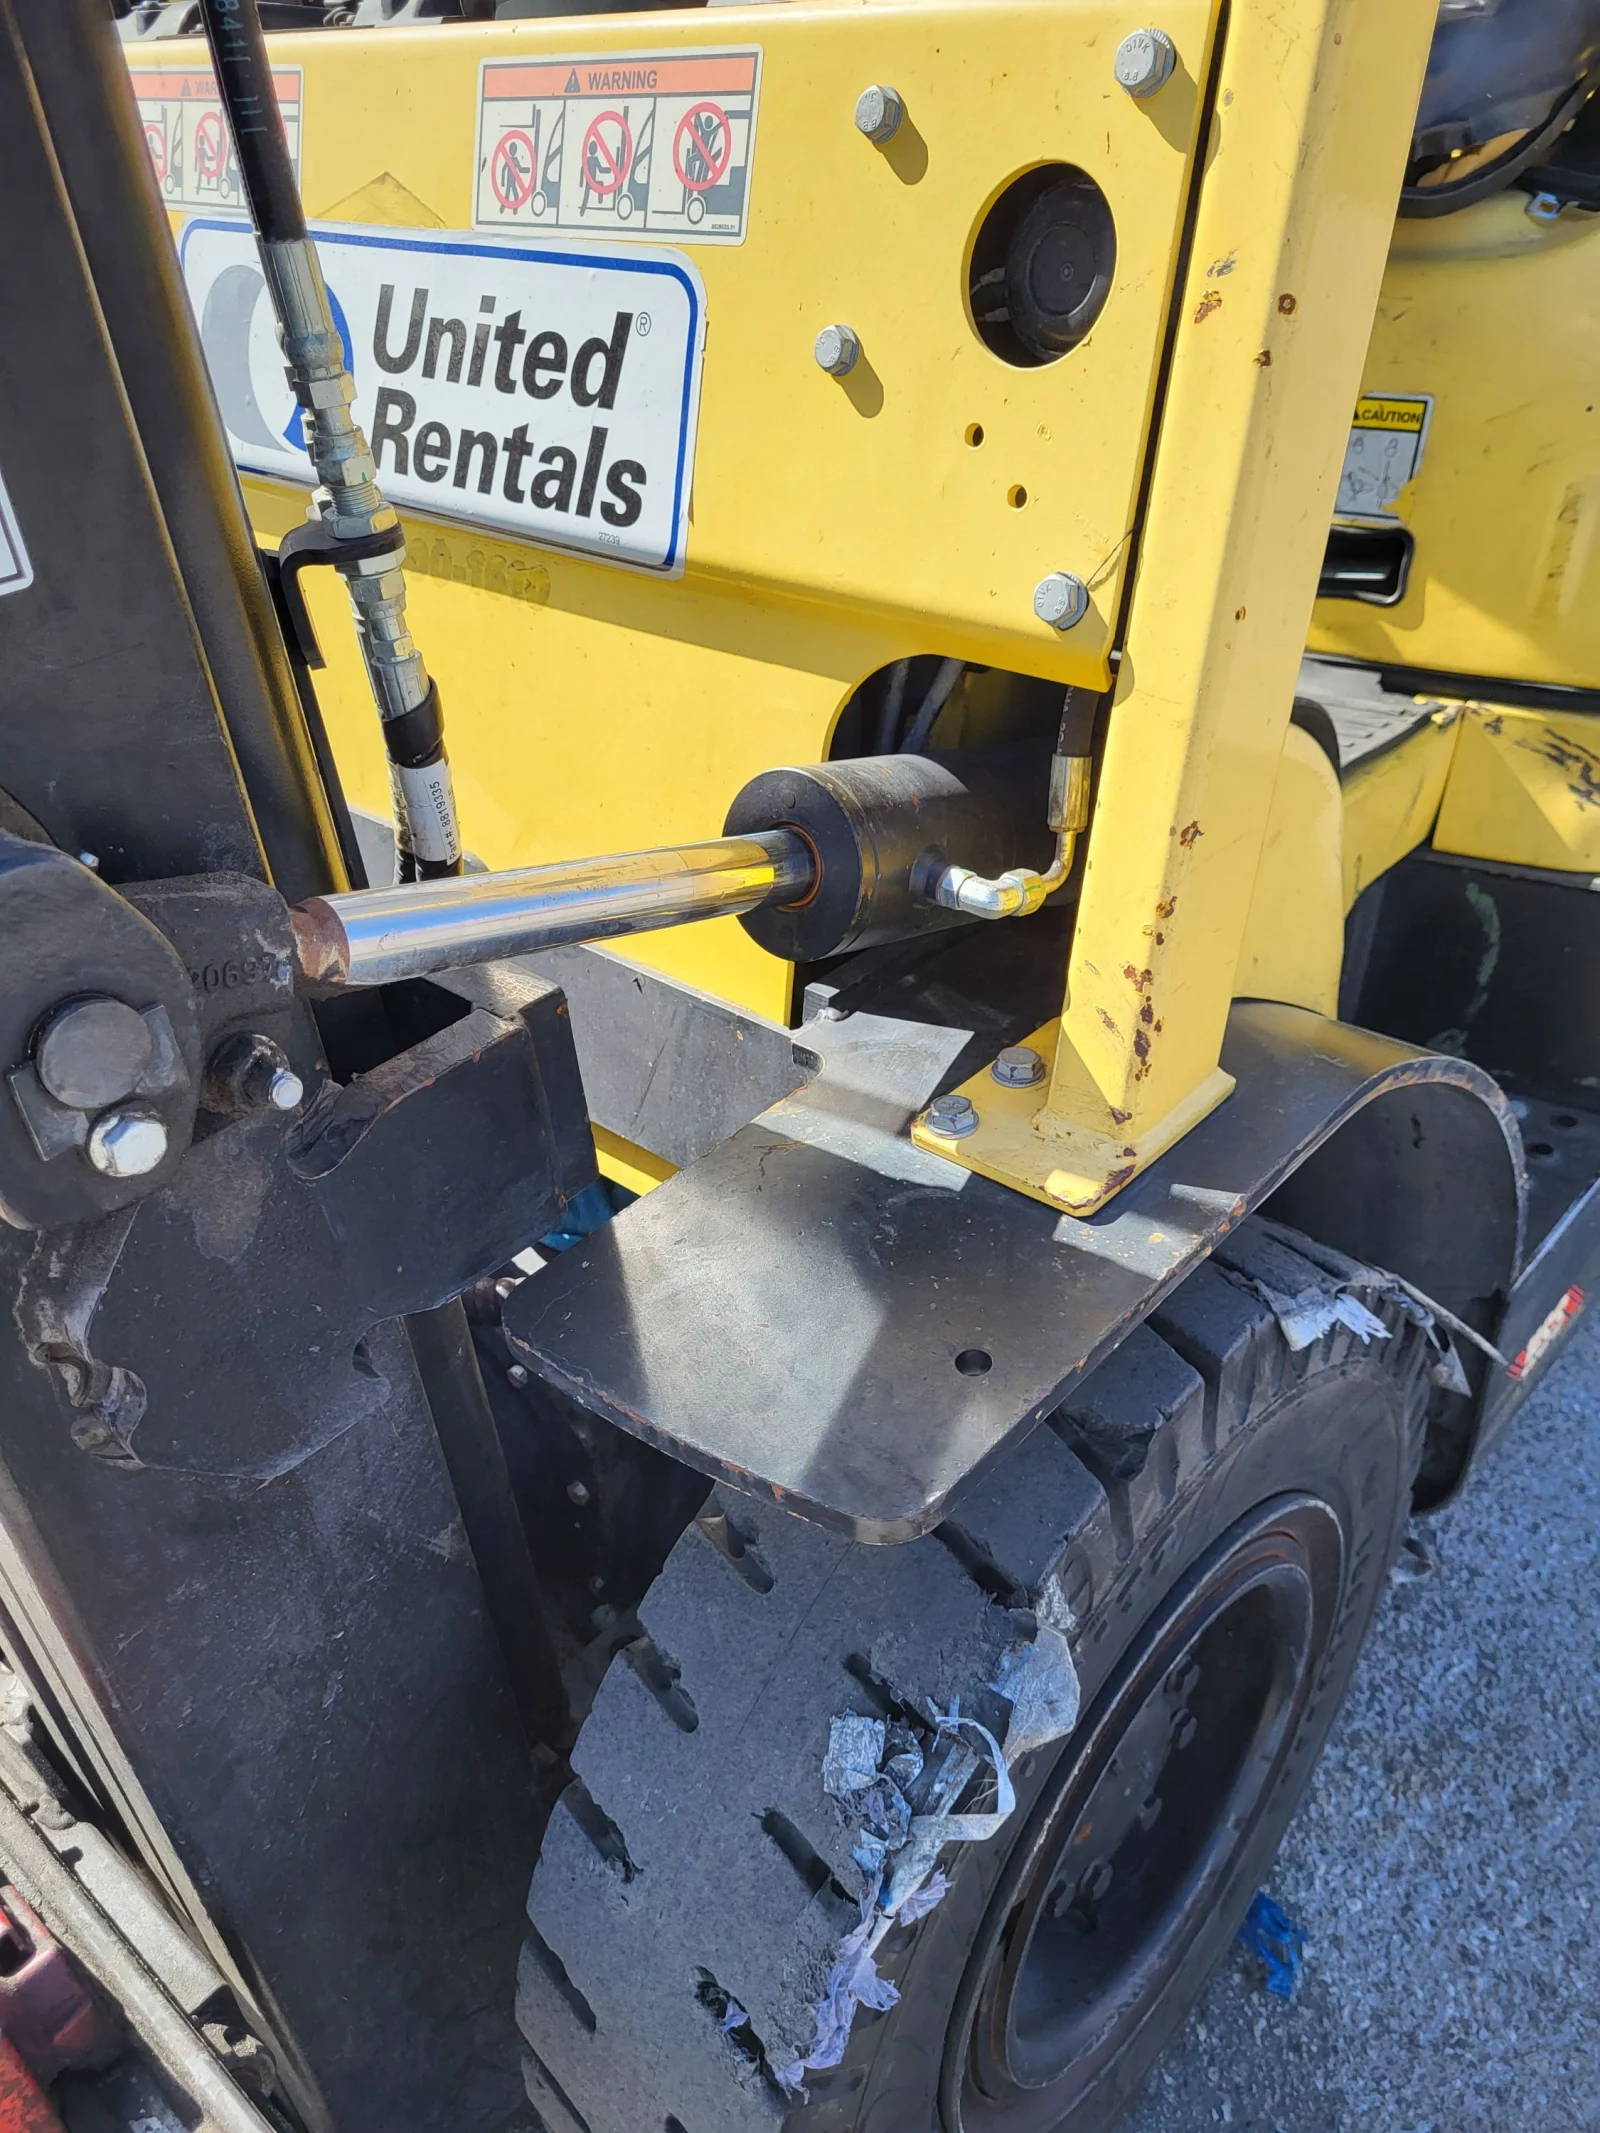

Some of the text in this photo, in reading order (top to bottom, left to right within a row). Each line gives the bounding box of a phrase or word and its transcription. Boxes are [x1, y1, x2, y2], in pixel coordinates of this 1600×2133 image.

[588, 69, 658, 91] WARNING
[373, 283, 634, 410] United
[1361, 408, 1420, 425] CAUTION
[370, 386, 648, 527] Rentals
[429, 781, 451, 828] 8819335
[447, 840, 457, 860] Part
